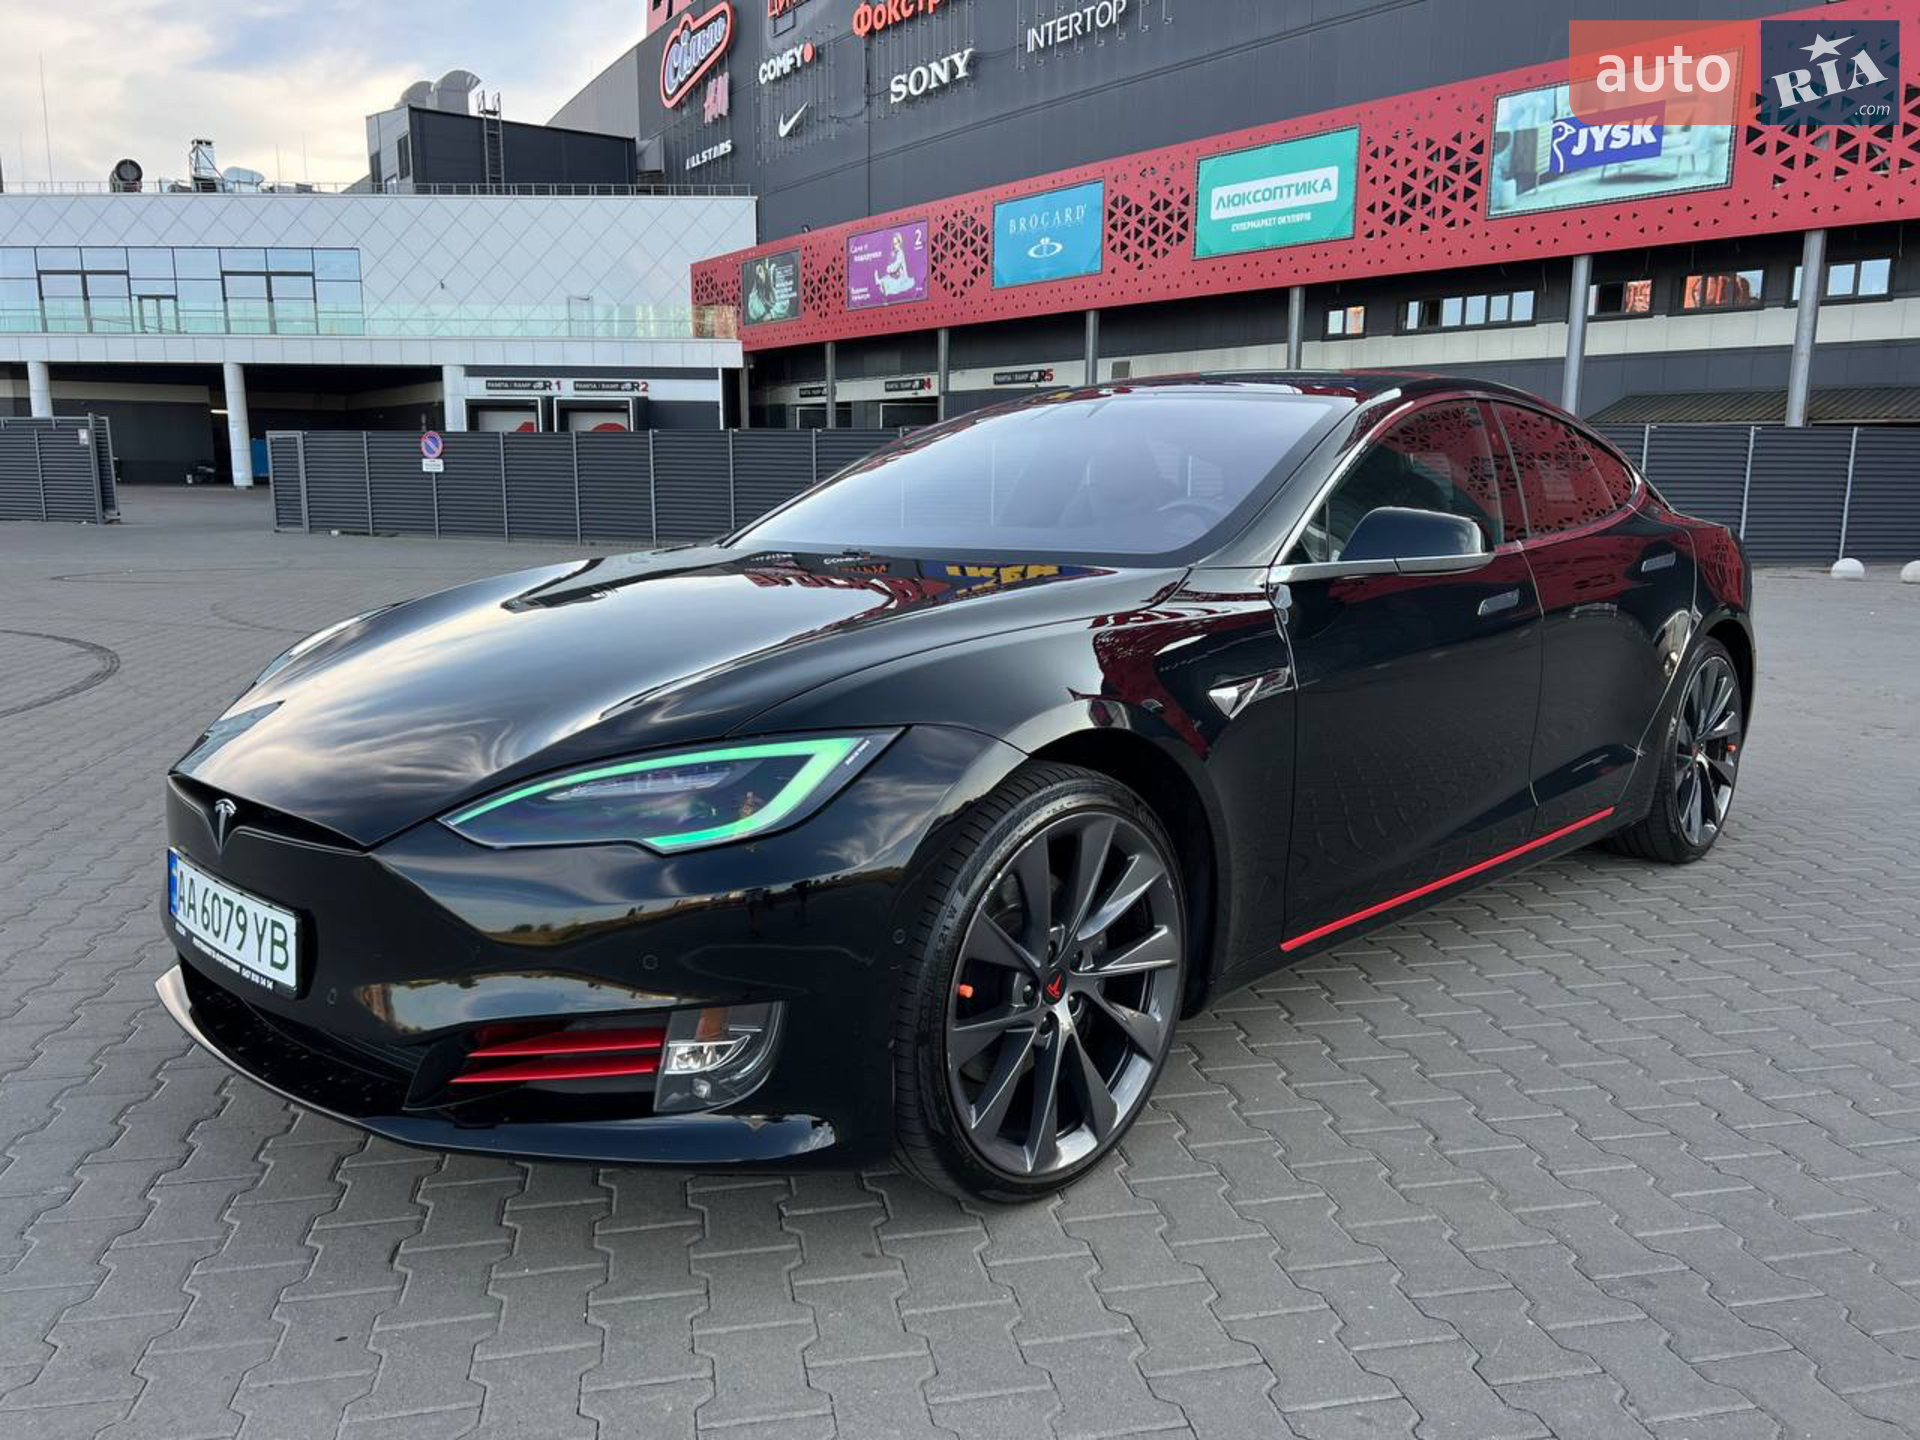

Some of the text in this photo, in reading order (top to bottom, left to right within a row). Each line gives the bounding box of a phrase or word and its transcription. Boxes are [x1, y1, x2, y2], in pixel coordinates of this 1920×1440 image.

[1027, 0, 1127, 53] INTERTOP
[759, 45, 804, 84] COMFY
[890, 48, 975, 103] SONY
[1571, 115, 1659, 155] JYSK
[1215, 178, 1332, 210] ЛЮКСОПТИКА
[915, 229, 922, 246] 2
[1009, 205, 1085, 235] BROCARD
